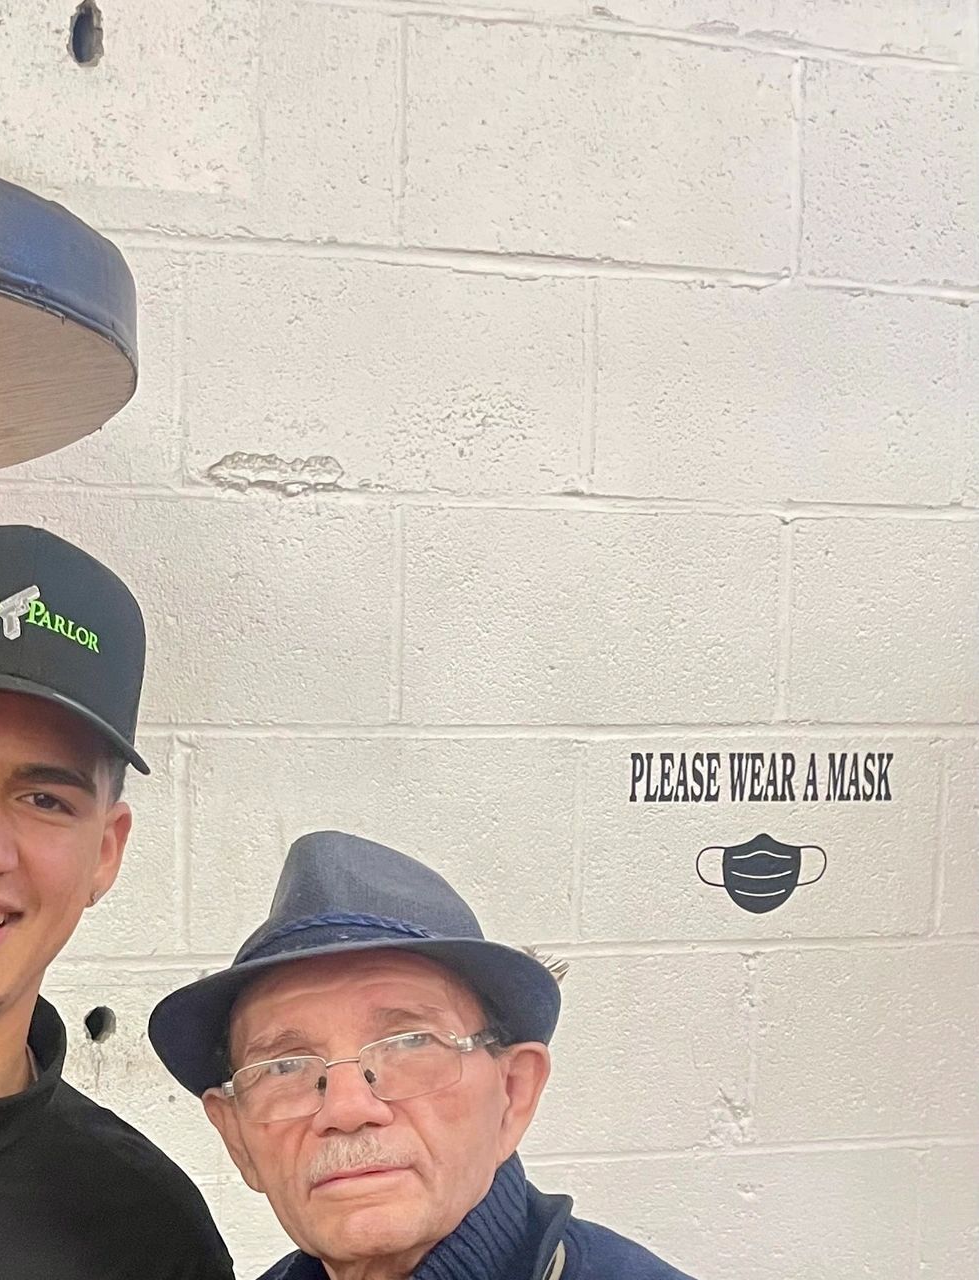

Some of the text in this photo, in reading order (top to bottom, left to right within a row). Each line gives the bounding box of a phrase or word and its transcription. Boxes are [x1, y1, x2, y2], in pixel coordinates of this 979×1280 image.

[25, 600, 100, 654] PARLOR
[629, 752, 894, 802] PLEASE WEAR A MASK
